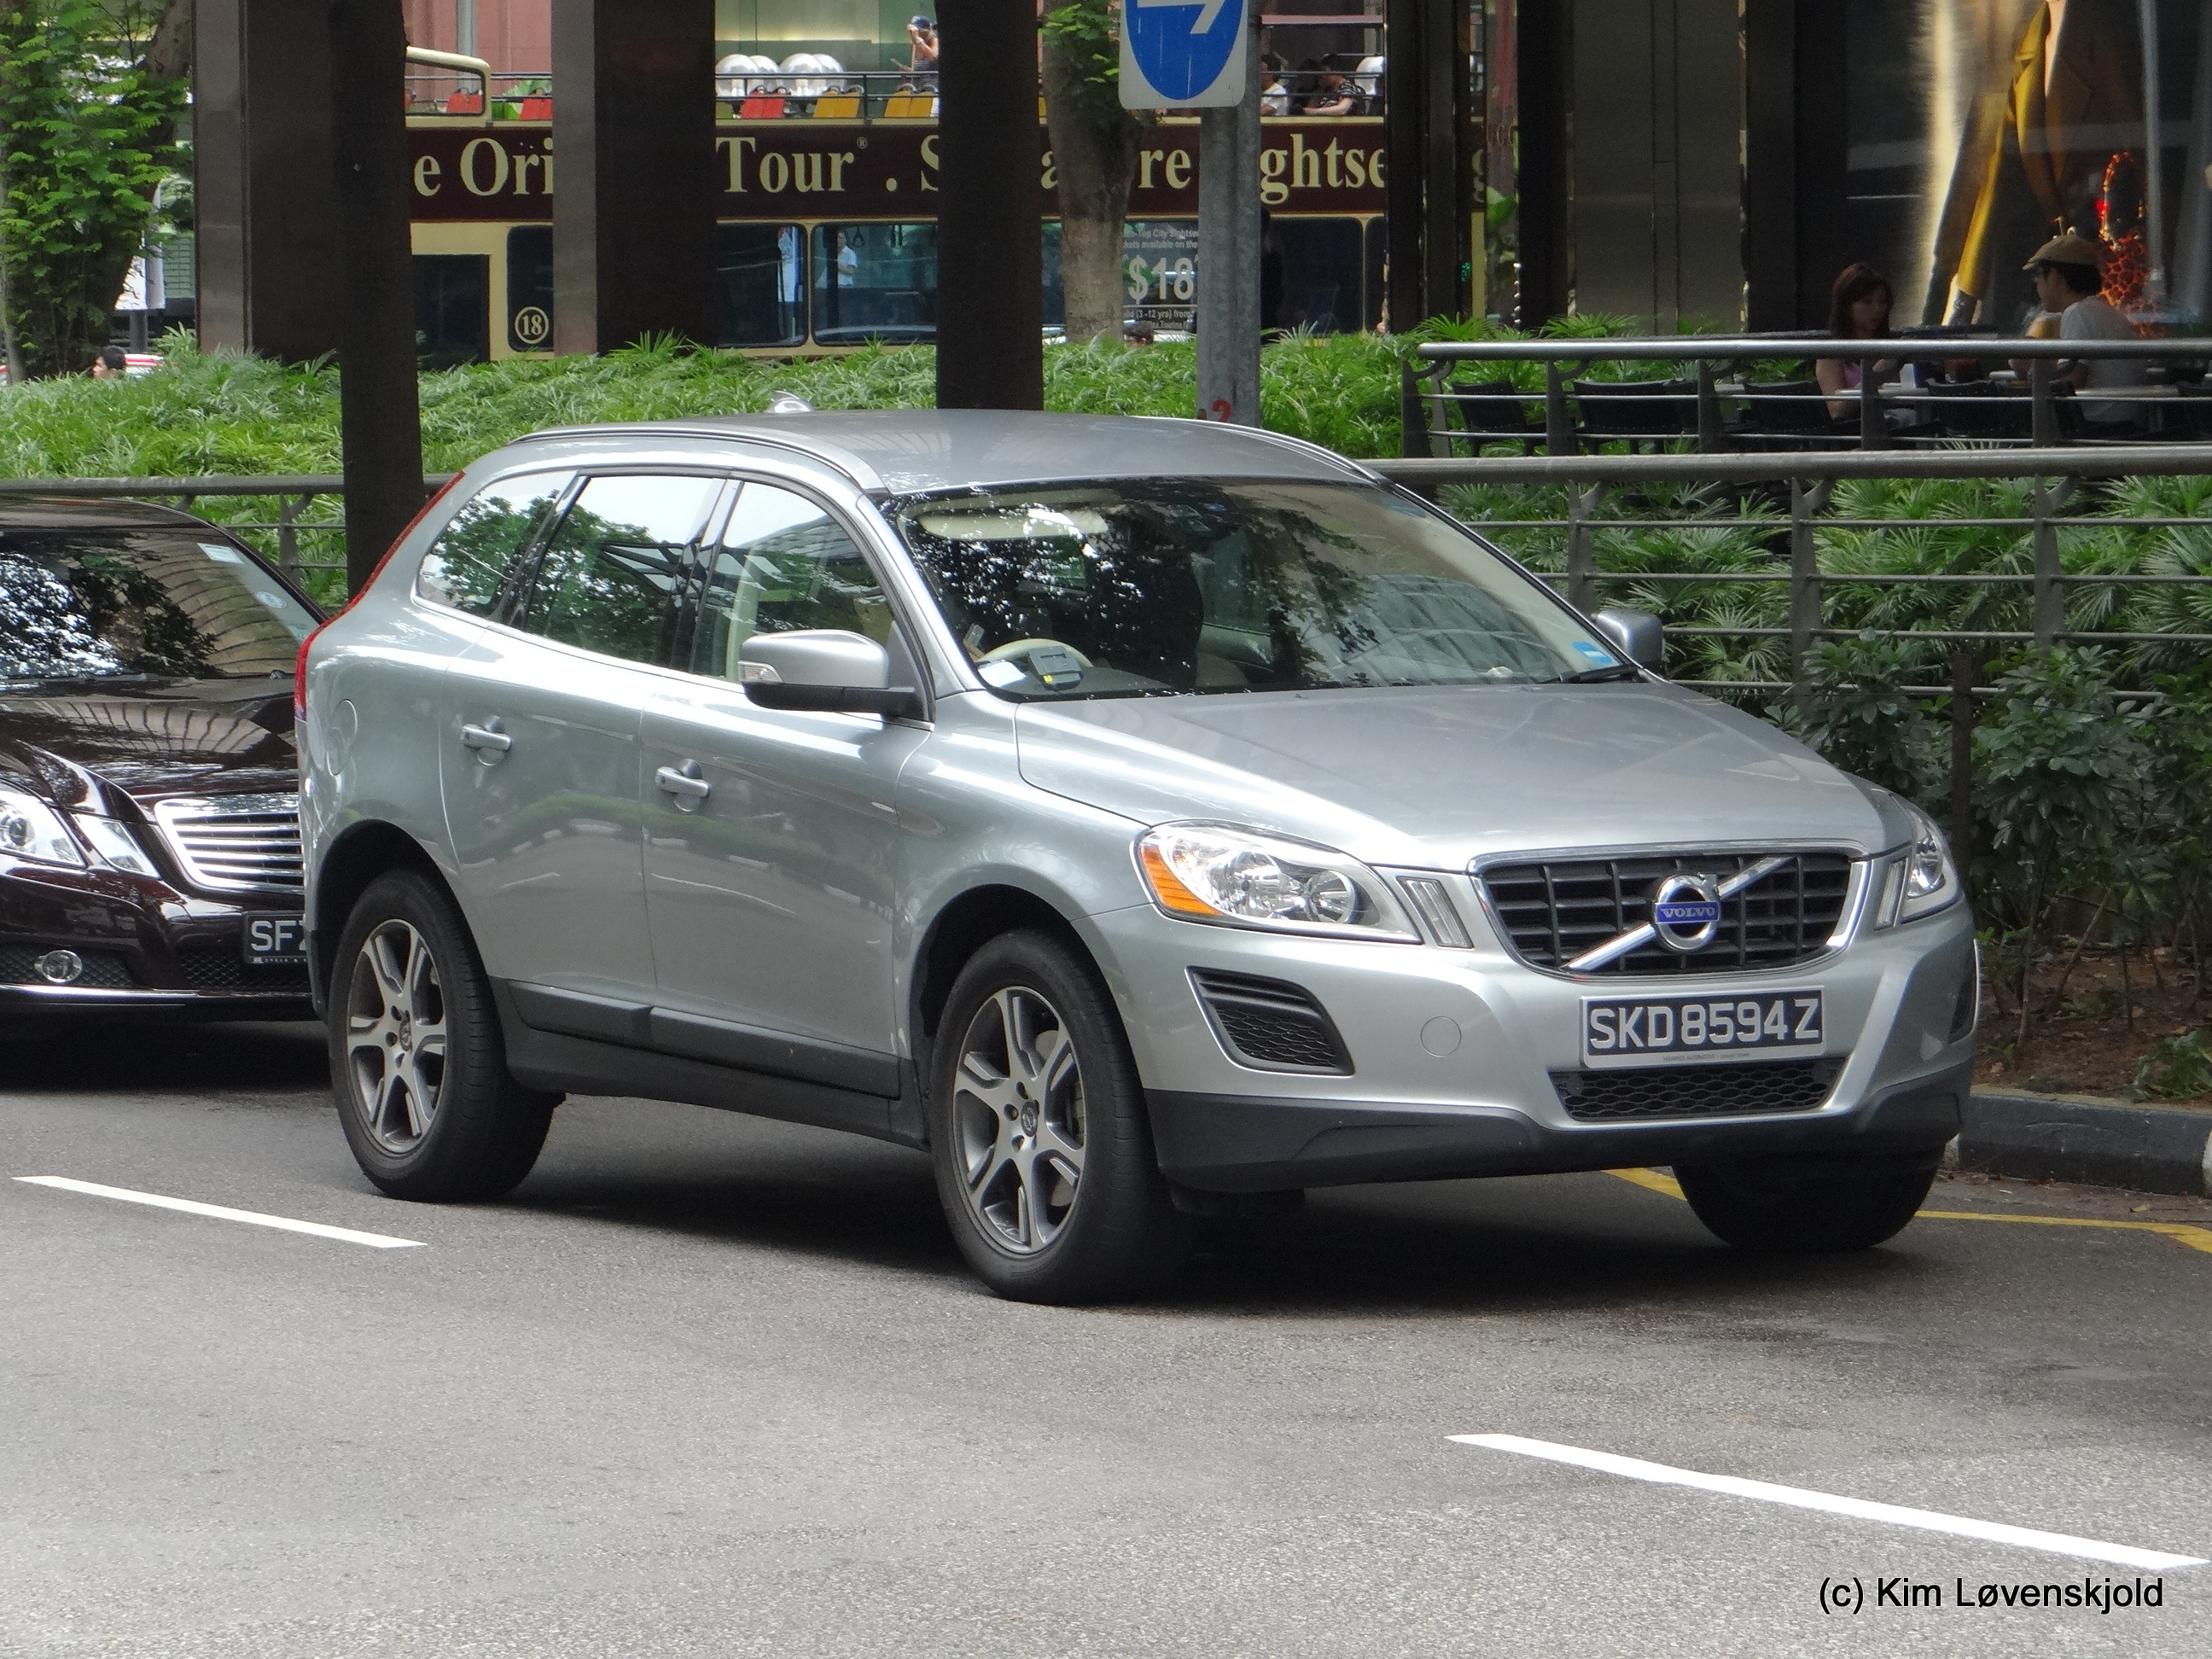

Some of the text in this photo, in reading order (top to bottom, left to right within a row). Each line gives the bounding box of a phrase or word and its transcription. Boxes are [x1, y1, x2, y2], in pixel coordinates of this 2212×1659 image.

[460, 137, 553, 196] Ori
[1260, 133, 1384, 204] ghtse
[522, 314, 542, 335] 18
[1660, 906, 1716, 918] VOLVO
[1590, 998, 1819, 1050] SKD8594Z
